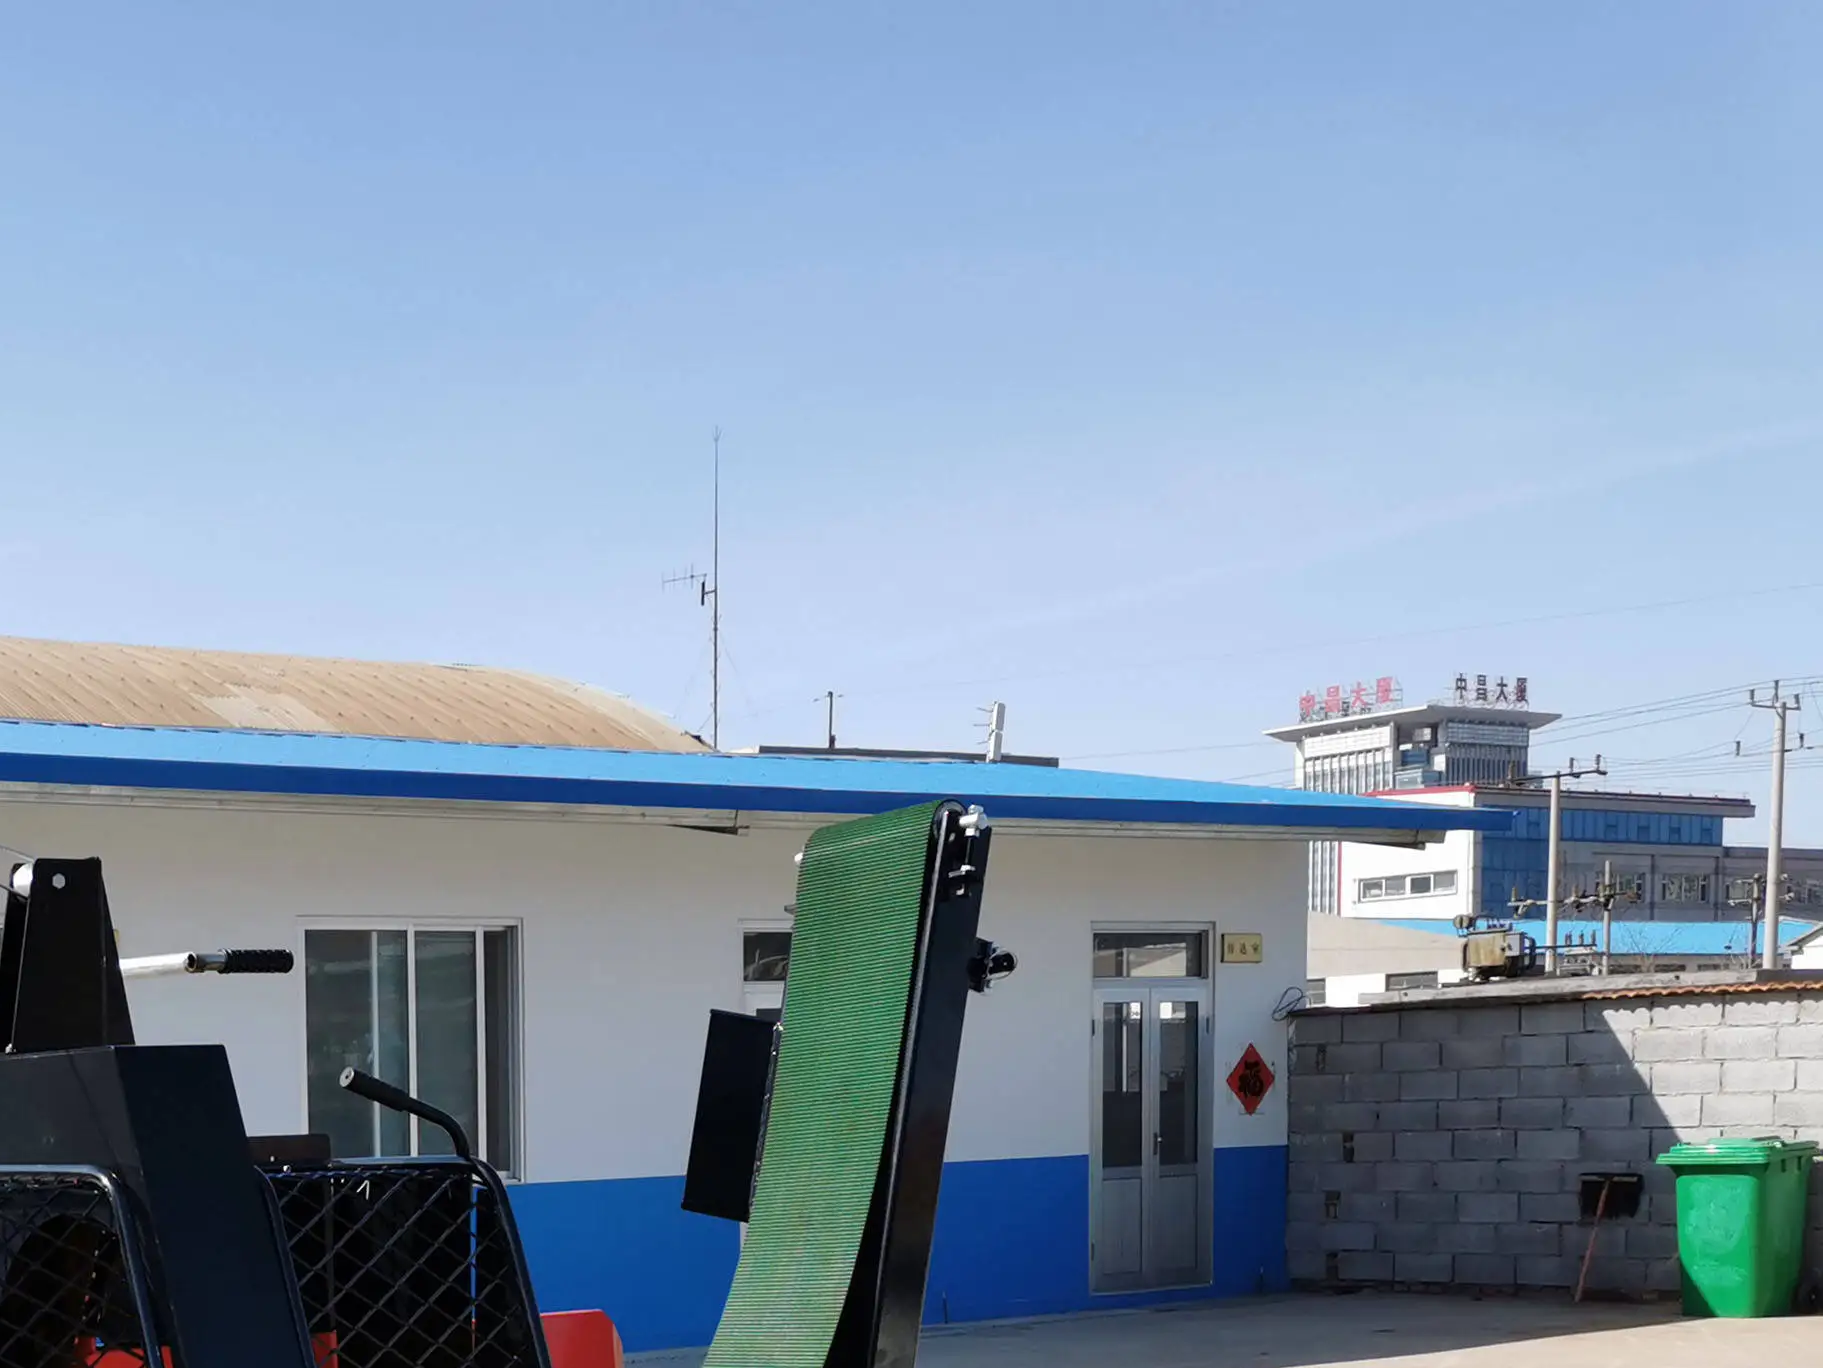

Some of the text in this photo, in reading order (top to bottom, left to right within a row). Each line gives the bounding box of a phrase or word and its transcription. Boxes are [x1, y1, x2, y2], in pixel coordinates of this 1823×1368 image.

[1455, 672, 1528, 703] 中昌大厦
[1238, 1061, 1264, 1098] 福
